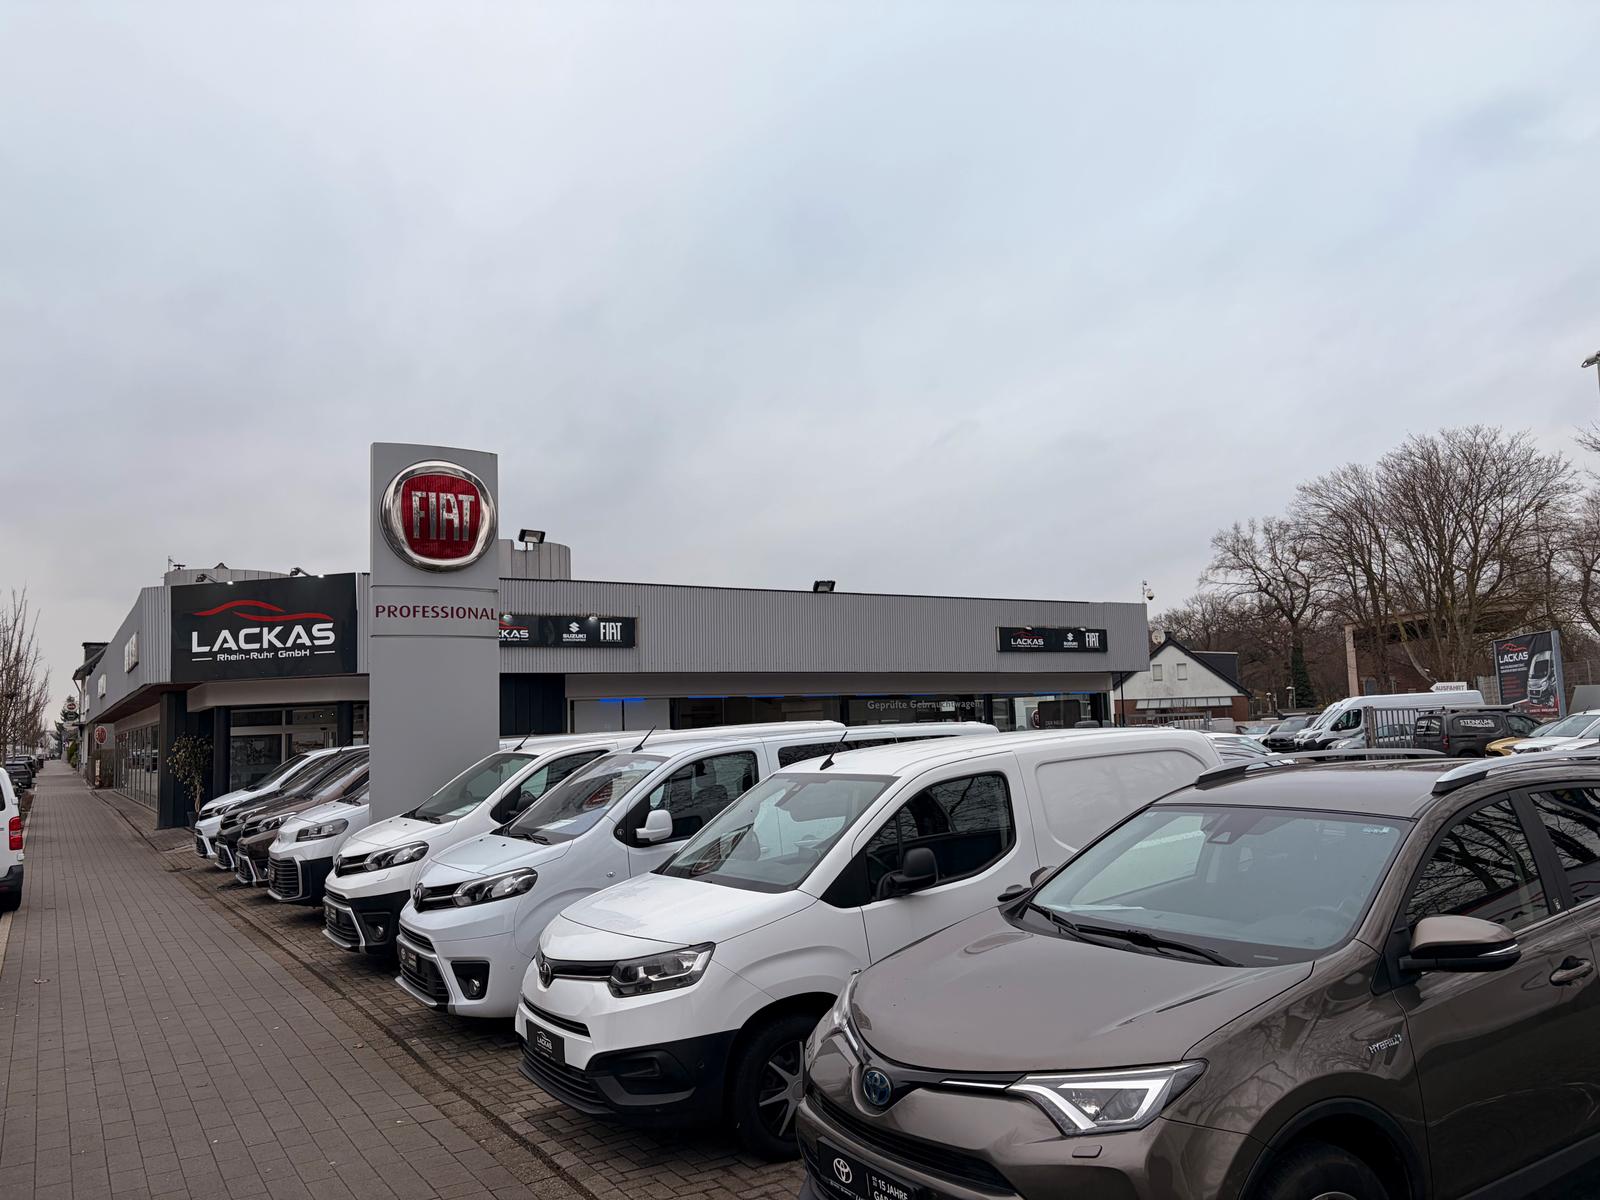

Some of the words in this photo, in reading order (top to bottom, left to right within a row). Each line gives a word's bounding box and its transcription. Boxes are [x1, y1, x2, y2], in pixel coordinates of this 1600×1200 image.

[412, 490, 475, 541] FIAT
[375, 605, 497, 620] PROFESSIONAL
[192, 623, 336, 653] LACKAS
[498, 629, 529, 638] KAS
[600, 622, 622, 640] FIAT
[1010, 638, 1045, 646] LACKAS
[1085, 632, 1100, 648] FIAT
[216, 652, 275, 662] Rhein-Ruhr
[278, 649, 310, 658] GmbH
[1498, 651, 1529, 663] LACKAS
[867, 700, 908, 711] Geprüfte
[878, 1179, 886, 1191] 15
[886, 1183, 908, 1200] JAHRE
